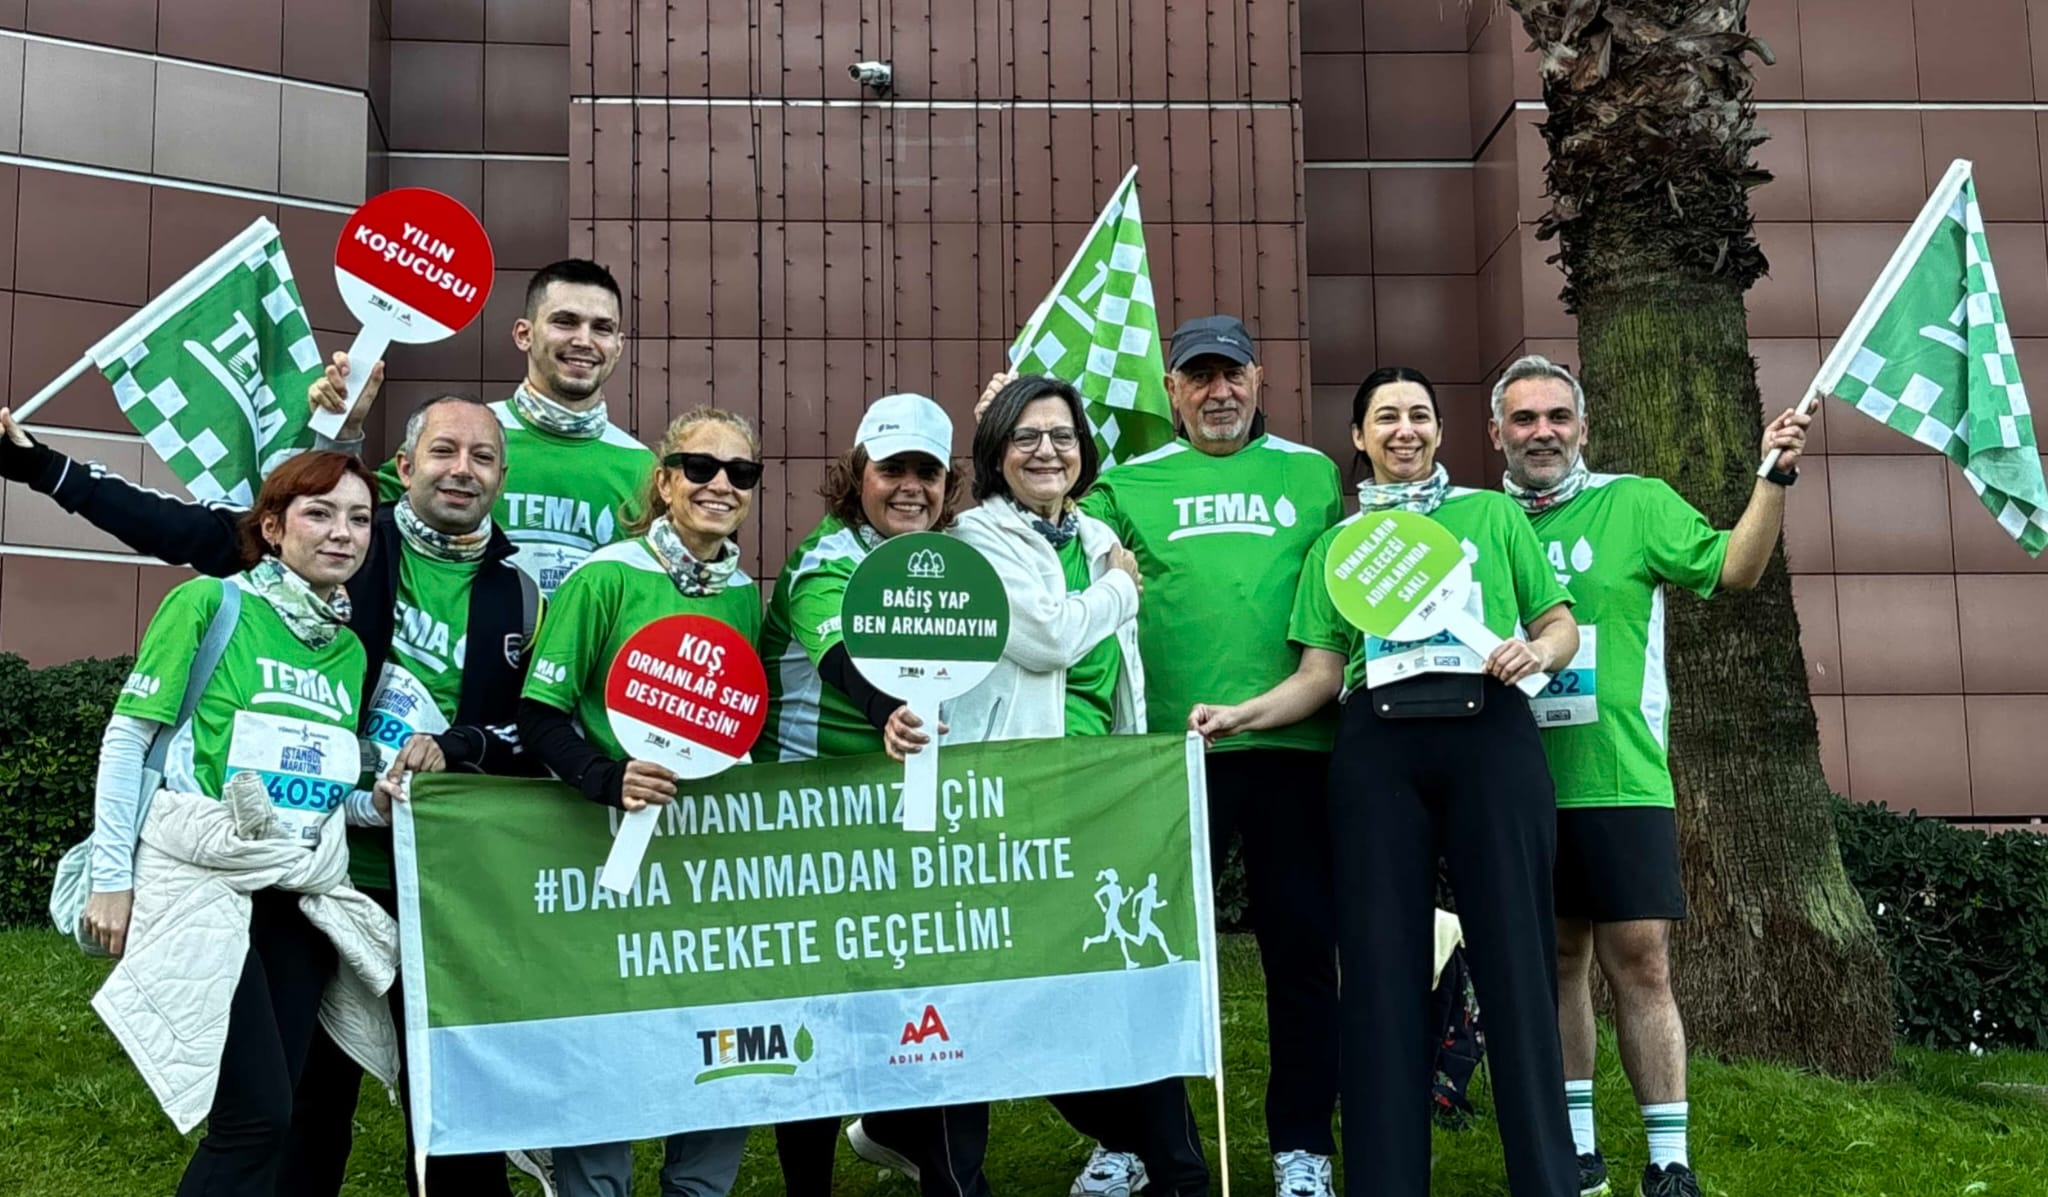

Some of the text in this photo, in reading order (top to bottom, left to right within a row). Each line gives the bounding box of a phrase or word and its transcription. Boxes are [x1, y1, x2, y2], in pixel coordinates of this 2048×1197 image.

[354, 224, 477, 303] KOŞUCUSU!
[402, 222, 455, 263] YILIN
[503, 492, 593, 536] TEMA
[1173, 492, 1271, 526] TEMA
[1334, 517, 1398, 580] ORMANLARIN
[1365, 541, 1432, 608] ADIMLARINDA
[1397, 571, 1431, 603] SAKLI
[882, 586, 970, 613] BAĞIŞ YAP
[853, 615, 998, 637] BEN ARKANDAYIM
[677, 633, 726, 677] KOŞ,
[256, 657, 337, 706] TEMA
[626, 650, 761, 716] ORMANLAR SENİ
[625, 679, 741, 739] DESTEKLESİN!
[267, 775, 344, 811] 4058
[607, 769, 1005, 838] MANLARIMIZ ÇİN
[683, 848, 897, 904] YANMADAN
[911, 832, 1075, 889] BİRLİKTE
[617, 901, 1014, 978] HAREKETE GEÇELİM!
[696, 1024, 788, 1066] TEMA
[889, 1049, 964, 1065] ADIM ADIM
